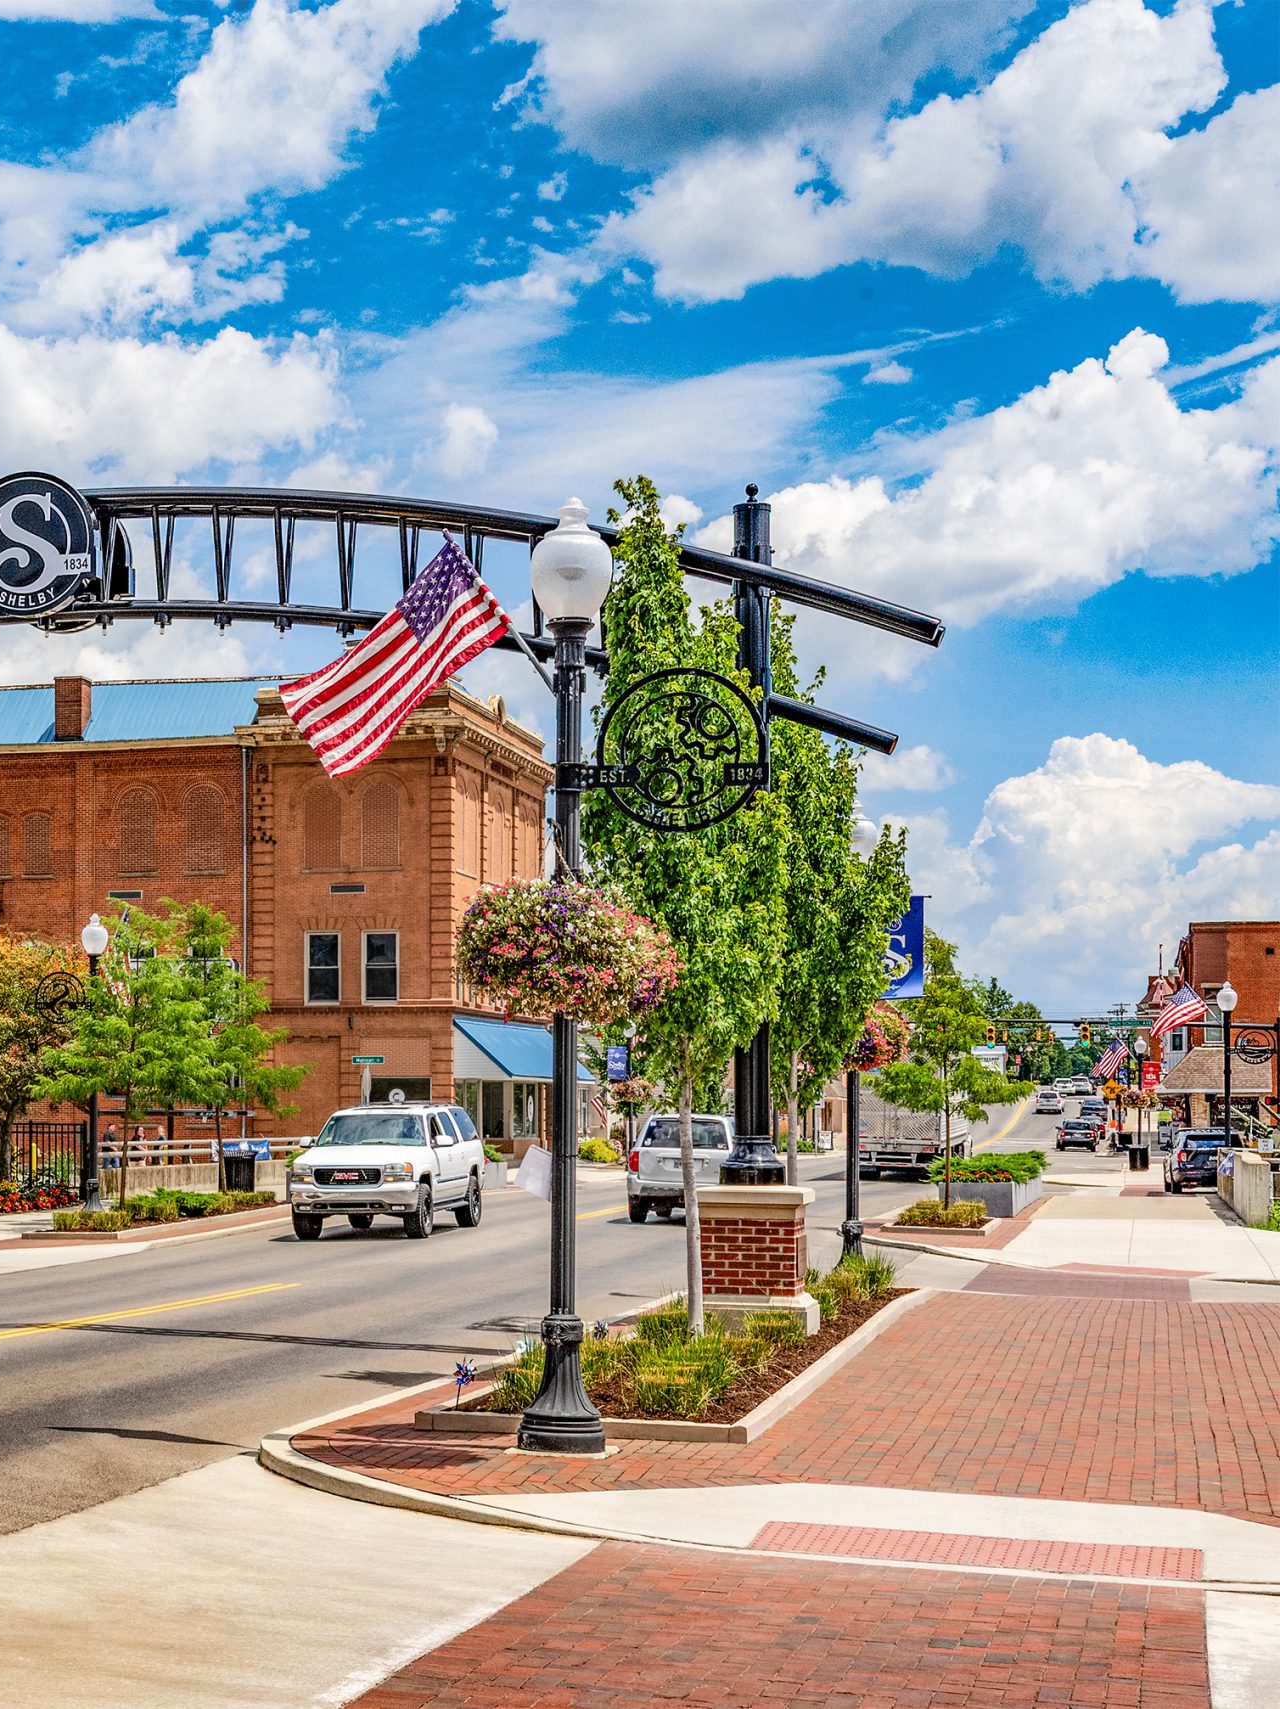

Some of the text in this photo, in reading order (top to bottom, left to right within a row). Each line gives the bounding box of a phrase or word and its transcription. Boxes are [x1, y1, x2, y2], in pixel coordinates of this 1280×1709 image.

[63, 558, 89, 571] 1834
[599, 767, 764, 783] EST. 1834
[637, 802, 727, 826] SHELBY
[334, 1172, 359, 1180] GMC
